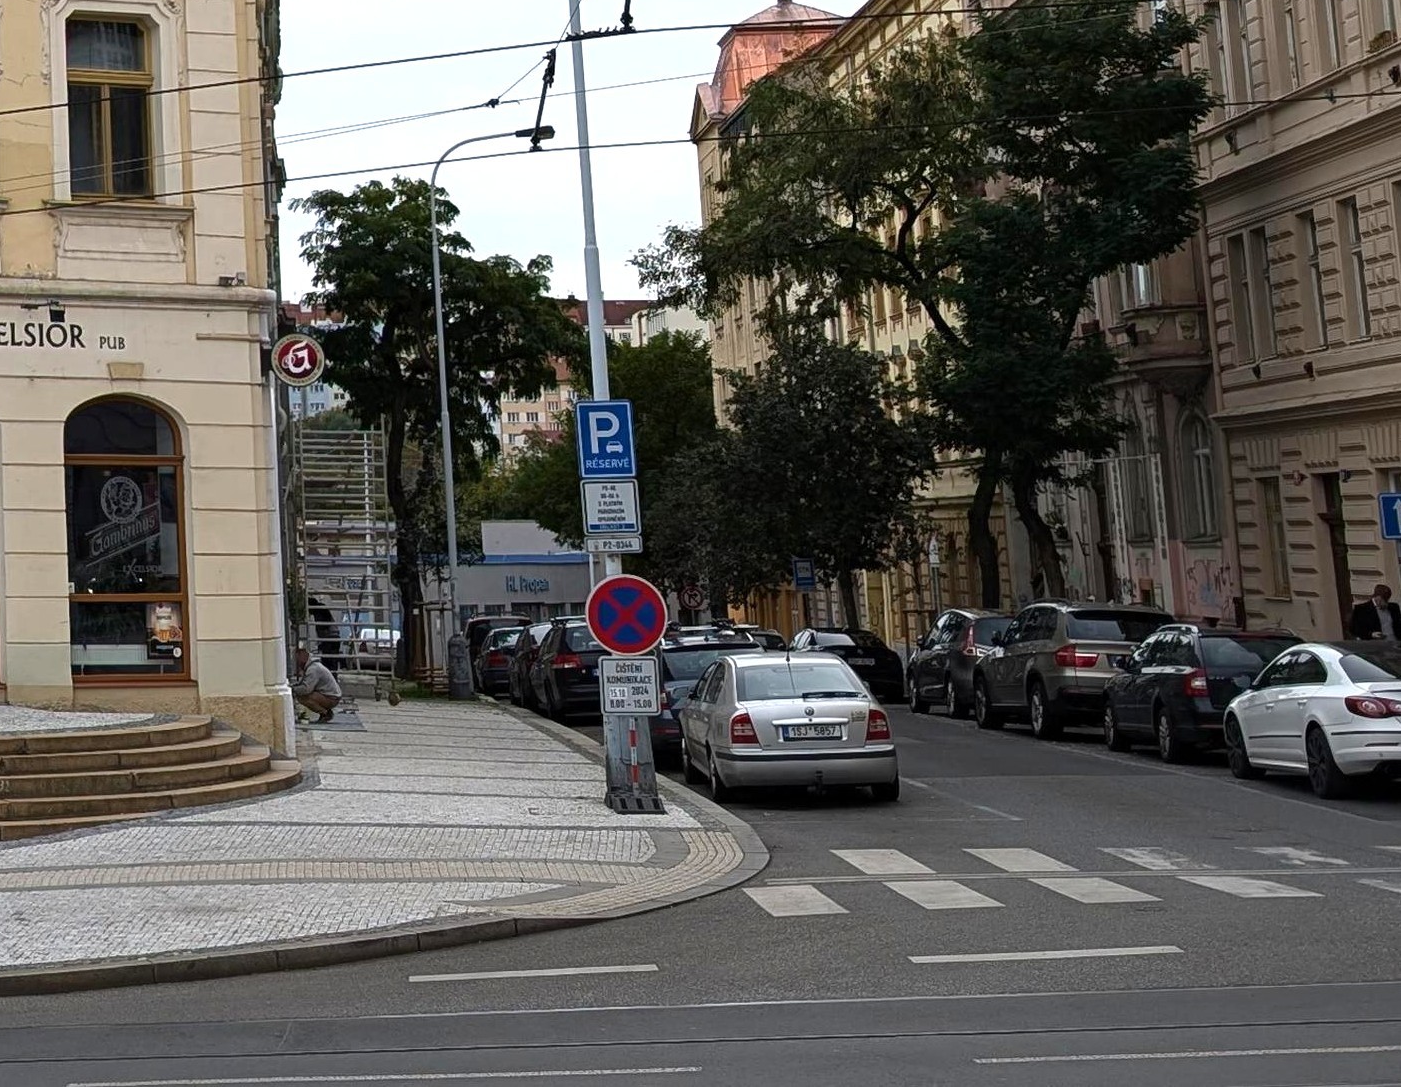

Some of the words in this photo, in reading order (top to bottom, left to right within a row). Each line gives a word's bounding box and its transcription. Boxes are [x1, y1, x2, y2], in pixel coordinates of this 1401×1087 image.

[99, 335, 126, 350] PUB
[588, 411, 620, 454] P
[585, 456, 631, 469] RÉSERVÉ
[505, 575, 518, 593] HL
[615, 662, 643, 674] ČIŠTĚNÍ
[607, 675, 653, 685] KOMUNIKACE
[631, 686, 649, 696] 2024
[791, 726, 808, 737] 1SJ
[812, 725, 837, 736] 5857
